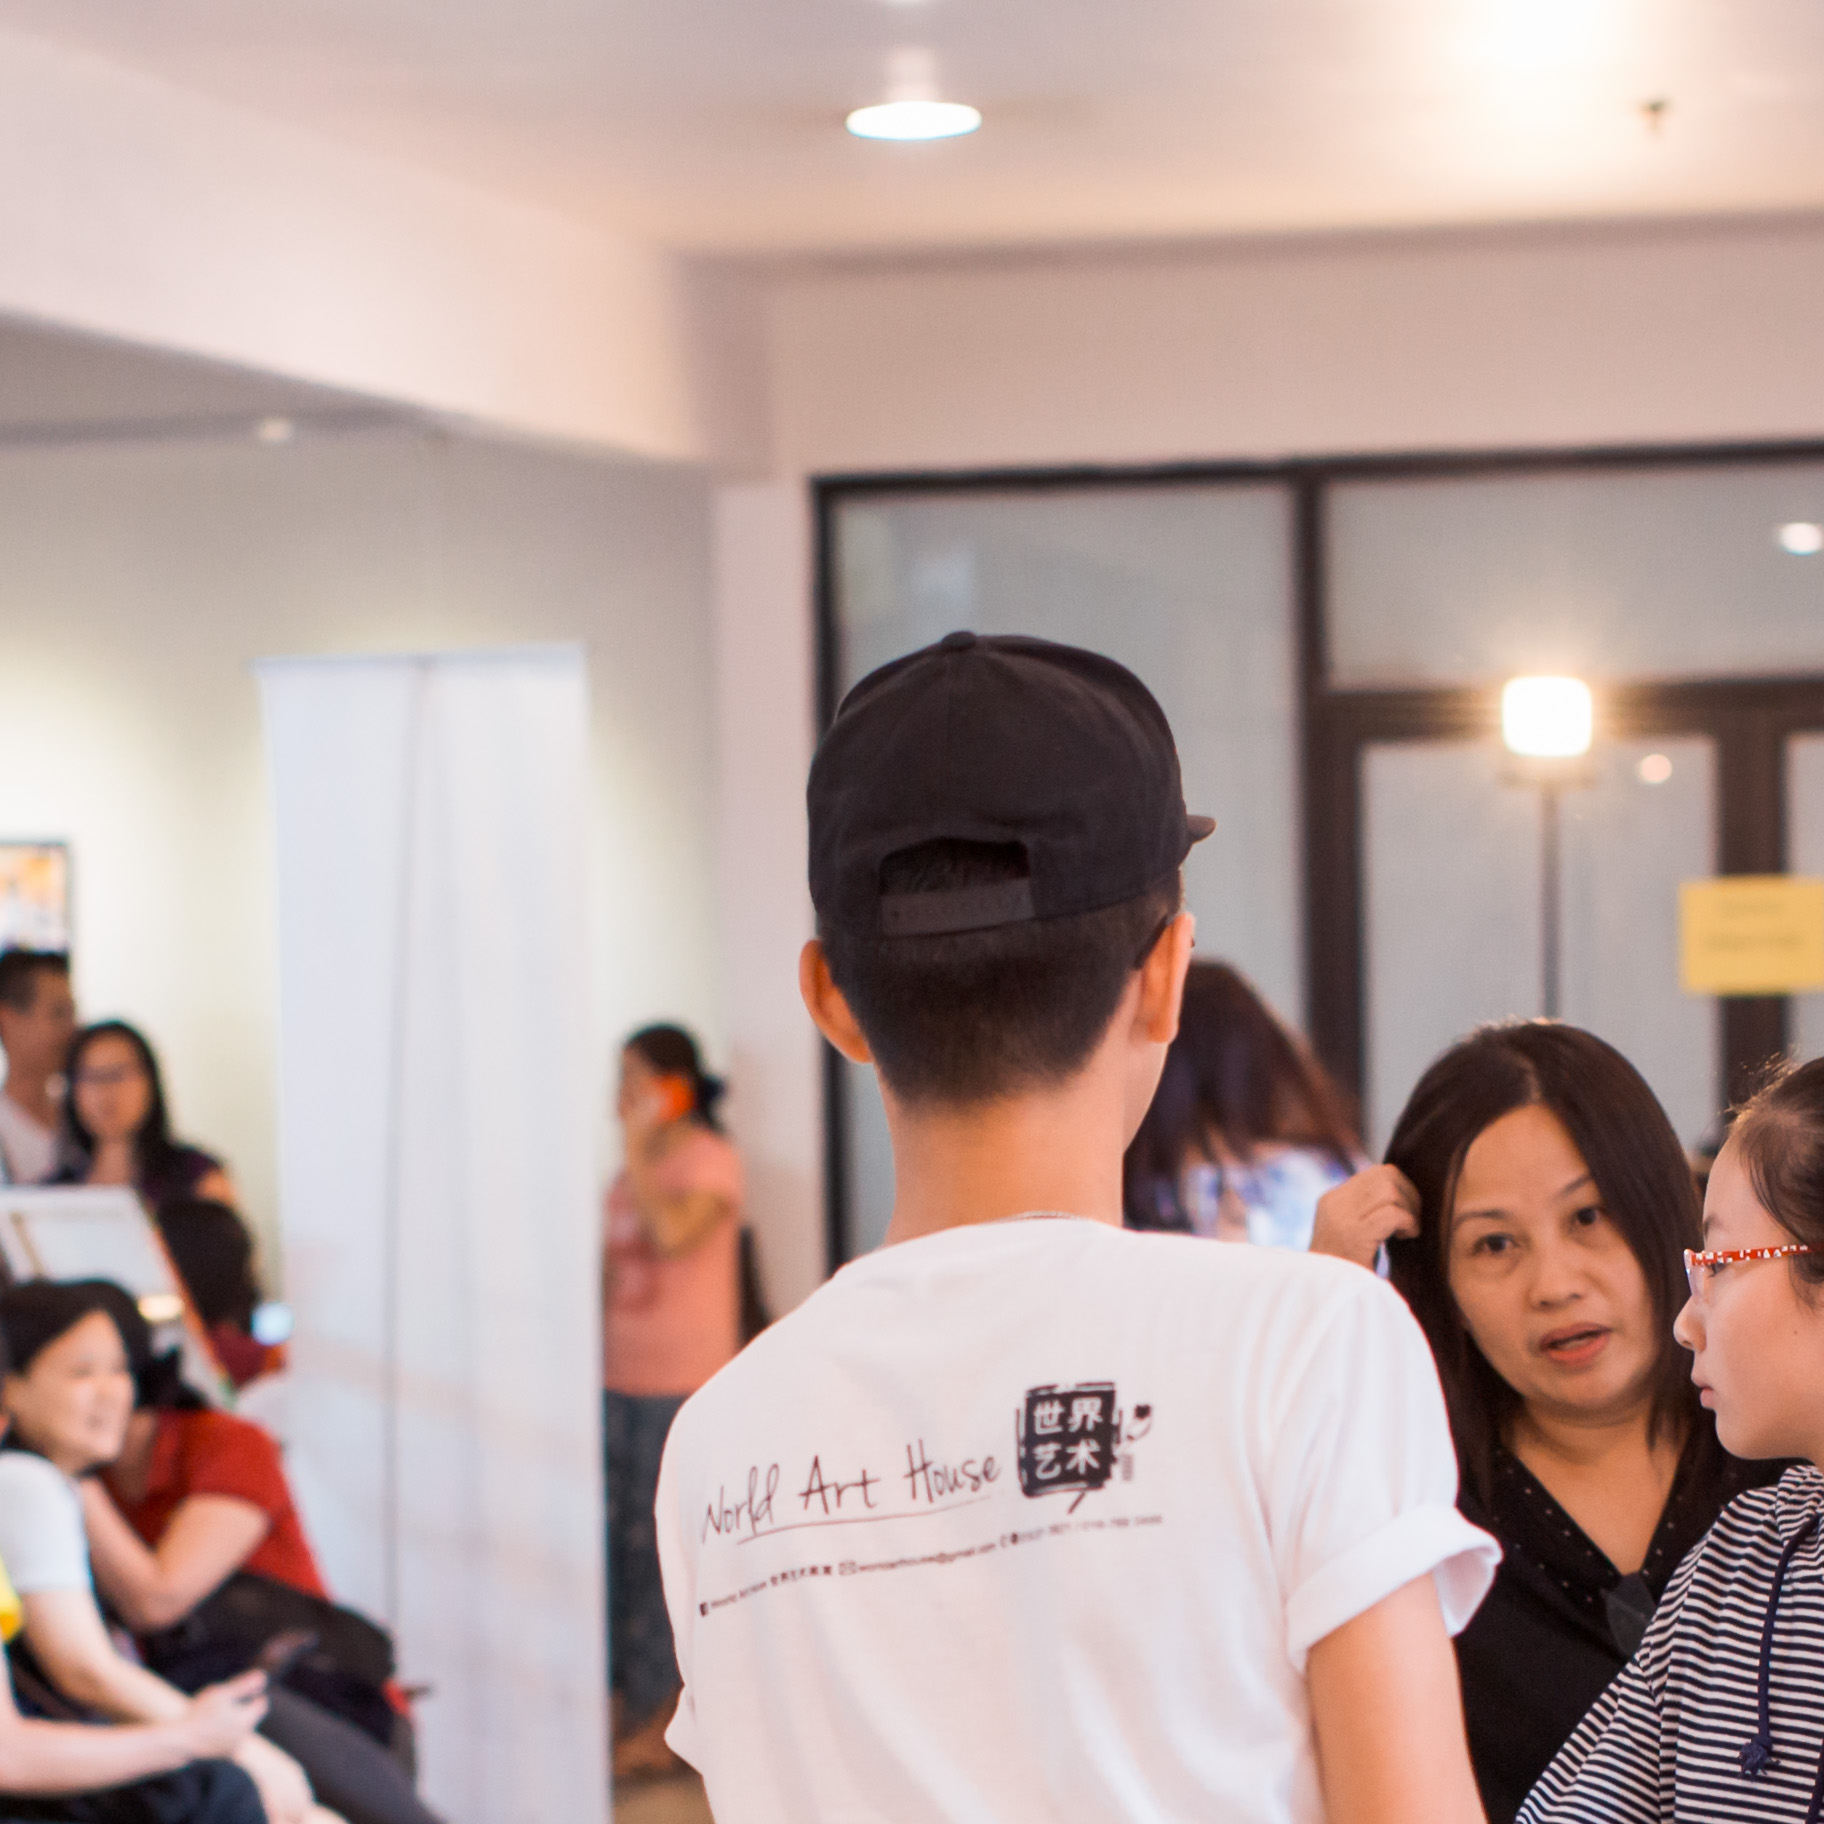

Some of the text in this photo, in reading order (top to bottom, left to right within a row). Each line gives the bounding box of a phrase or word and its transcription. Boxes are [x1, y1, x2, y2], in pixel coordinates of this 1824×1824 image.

[1033, 1396, 1103, 1435] 世界
[798, 1455, 880, 1515] Art
[903, 1438, 1002, 1504] House
[1033, 1438, 1101, 1480] 艺术
